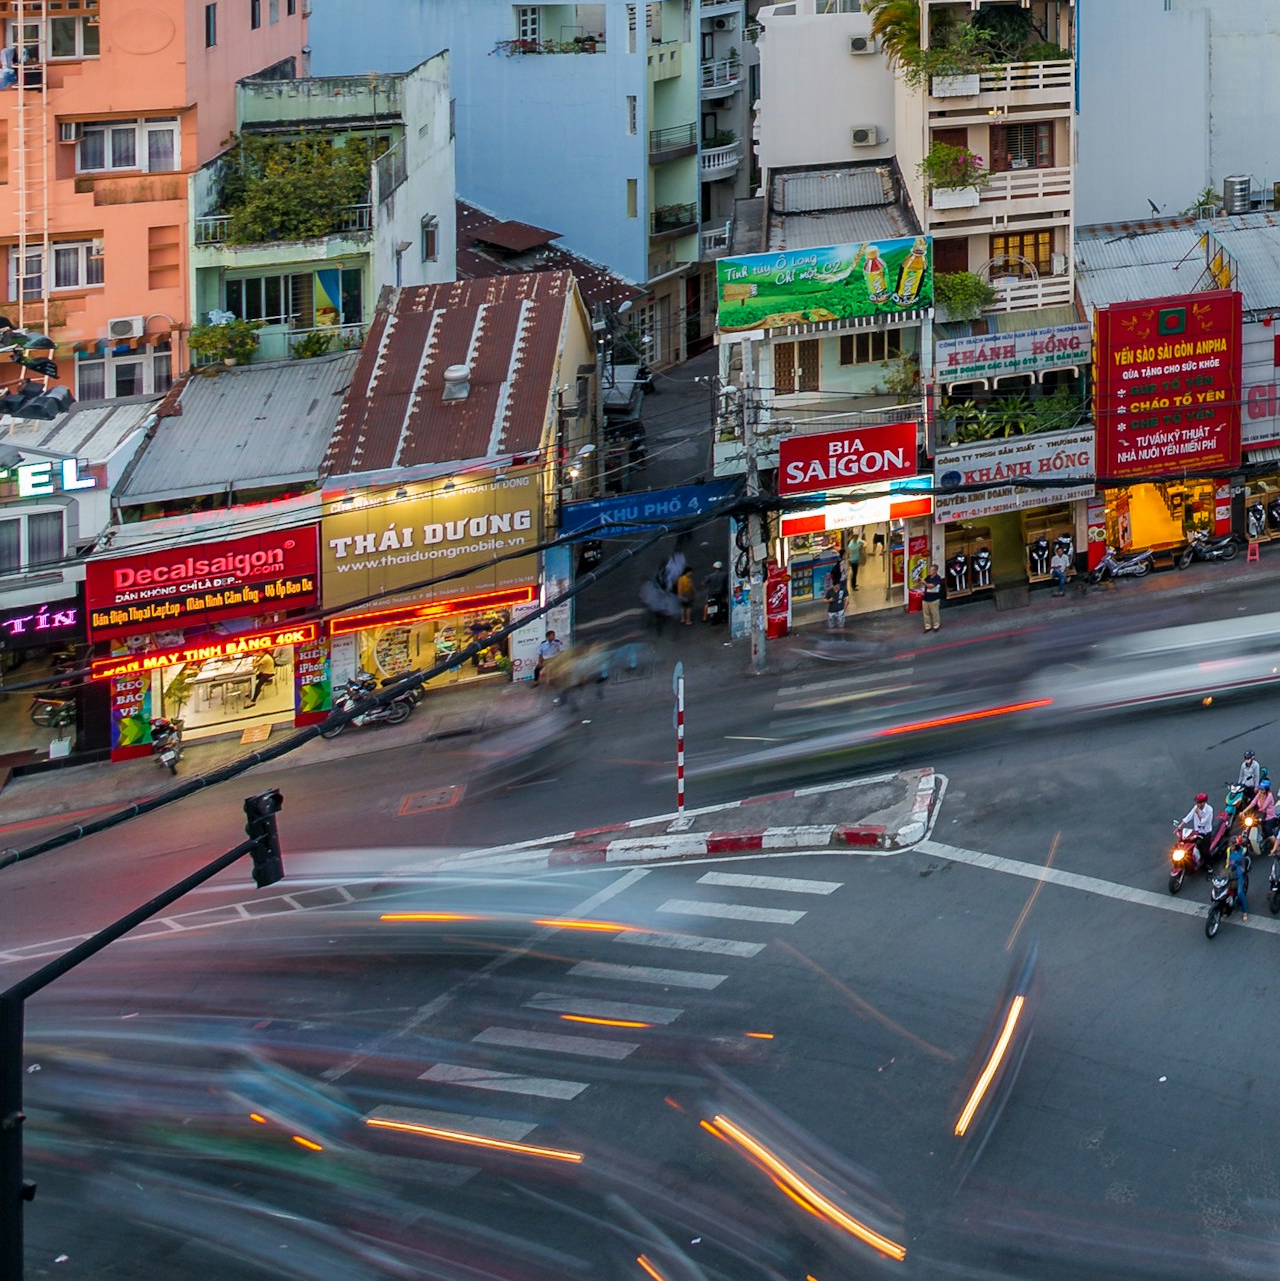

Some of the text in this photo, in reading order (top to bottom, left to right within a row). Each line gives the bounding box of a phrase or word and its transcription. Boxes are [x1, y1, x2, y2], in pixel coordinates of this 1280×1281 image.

[775, 254, 786, 270] Ô
[791, 255, 818, 268] Long
[822, 261, 842, 275] C2
[948, 344, 1015, 367] KHÁNH
[1031, 334, 1081, 355] HỒNG
[1114, 338, 1227, 366] YẾN SÀO SÀI GÒN ANPHA
[1141, 367, 1162, 378] TẶNG
[1163, 364, 1180, 374] CHO
[1181, 360, 1197, 371] SỨC
[1130, 398, 1169, 413] CHÁO
[829, 439, 864, 456] BIA
[1118, 449, 1136, 463] NHÀ
[1138, 445, 1160, 460] NUÔI
[1161, 441, 1179, 457] YẾN
[1202, 436, 1217, 450] PHÍ
[1136, 425, 1210, 447] TƯ VẤN KỸ THUẬT
[938, 455, 960, 465] CÔNG
[1015, 443, 1036, 453] XUẤT
[1046, 437, 1078, 448] THƯƠNG
[1079, 435, 1093, 443] MẠI
[0, 458, 96, 497] EL
[786, 448, 904, 485] SAIGON
[963, 461, 1032, 485] KHÁNH
[1038, 451, 1090, 473] HỒNG
[600, 505, 638, 522] KHU
[644, 495, 681, 517] PHỐ
[688, 497, 699, 509] 4
[330, 522, 413, 559] THÁI
[424, 510, 531, 545] DƯƠNG
[114, 547, 284, 589] Decalsaigon
[337, 536, 525, 573] www.thaiduongmobile.vn
[250, 562, 285, 576] .com
[92, 610, 109, 627] Dán
[110, 607, 128, 626] Điện
[129, 605, 150, 622] Thoại
[151, 602, 181, 619] Laptop
[224, 588, 242, 605] Cảm
[286, 581, 301, 596] Bao
[302, 578, 313, 592] Da
[2, 605, 77, 634] TÍN
[275, 629, 305, 645] 40K
[299, 661, 329, 674] iPhone
[301, 674, 328, 685] iPad
